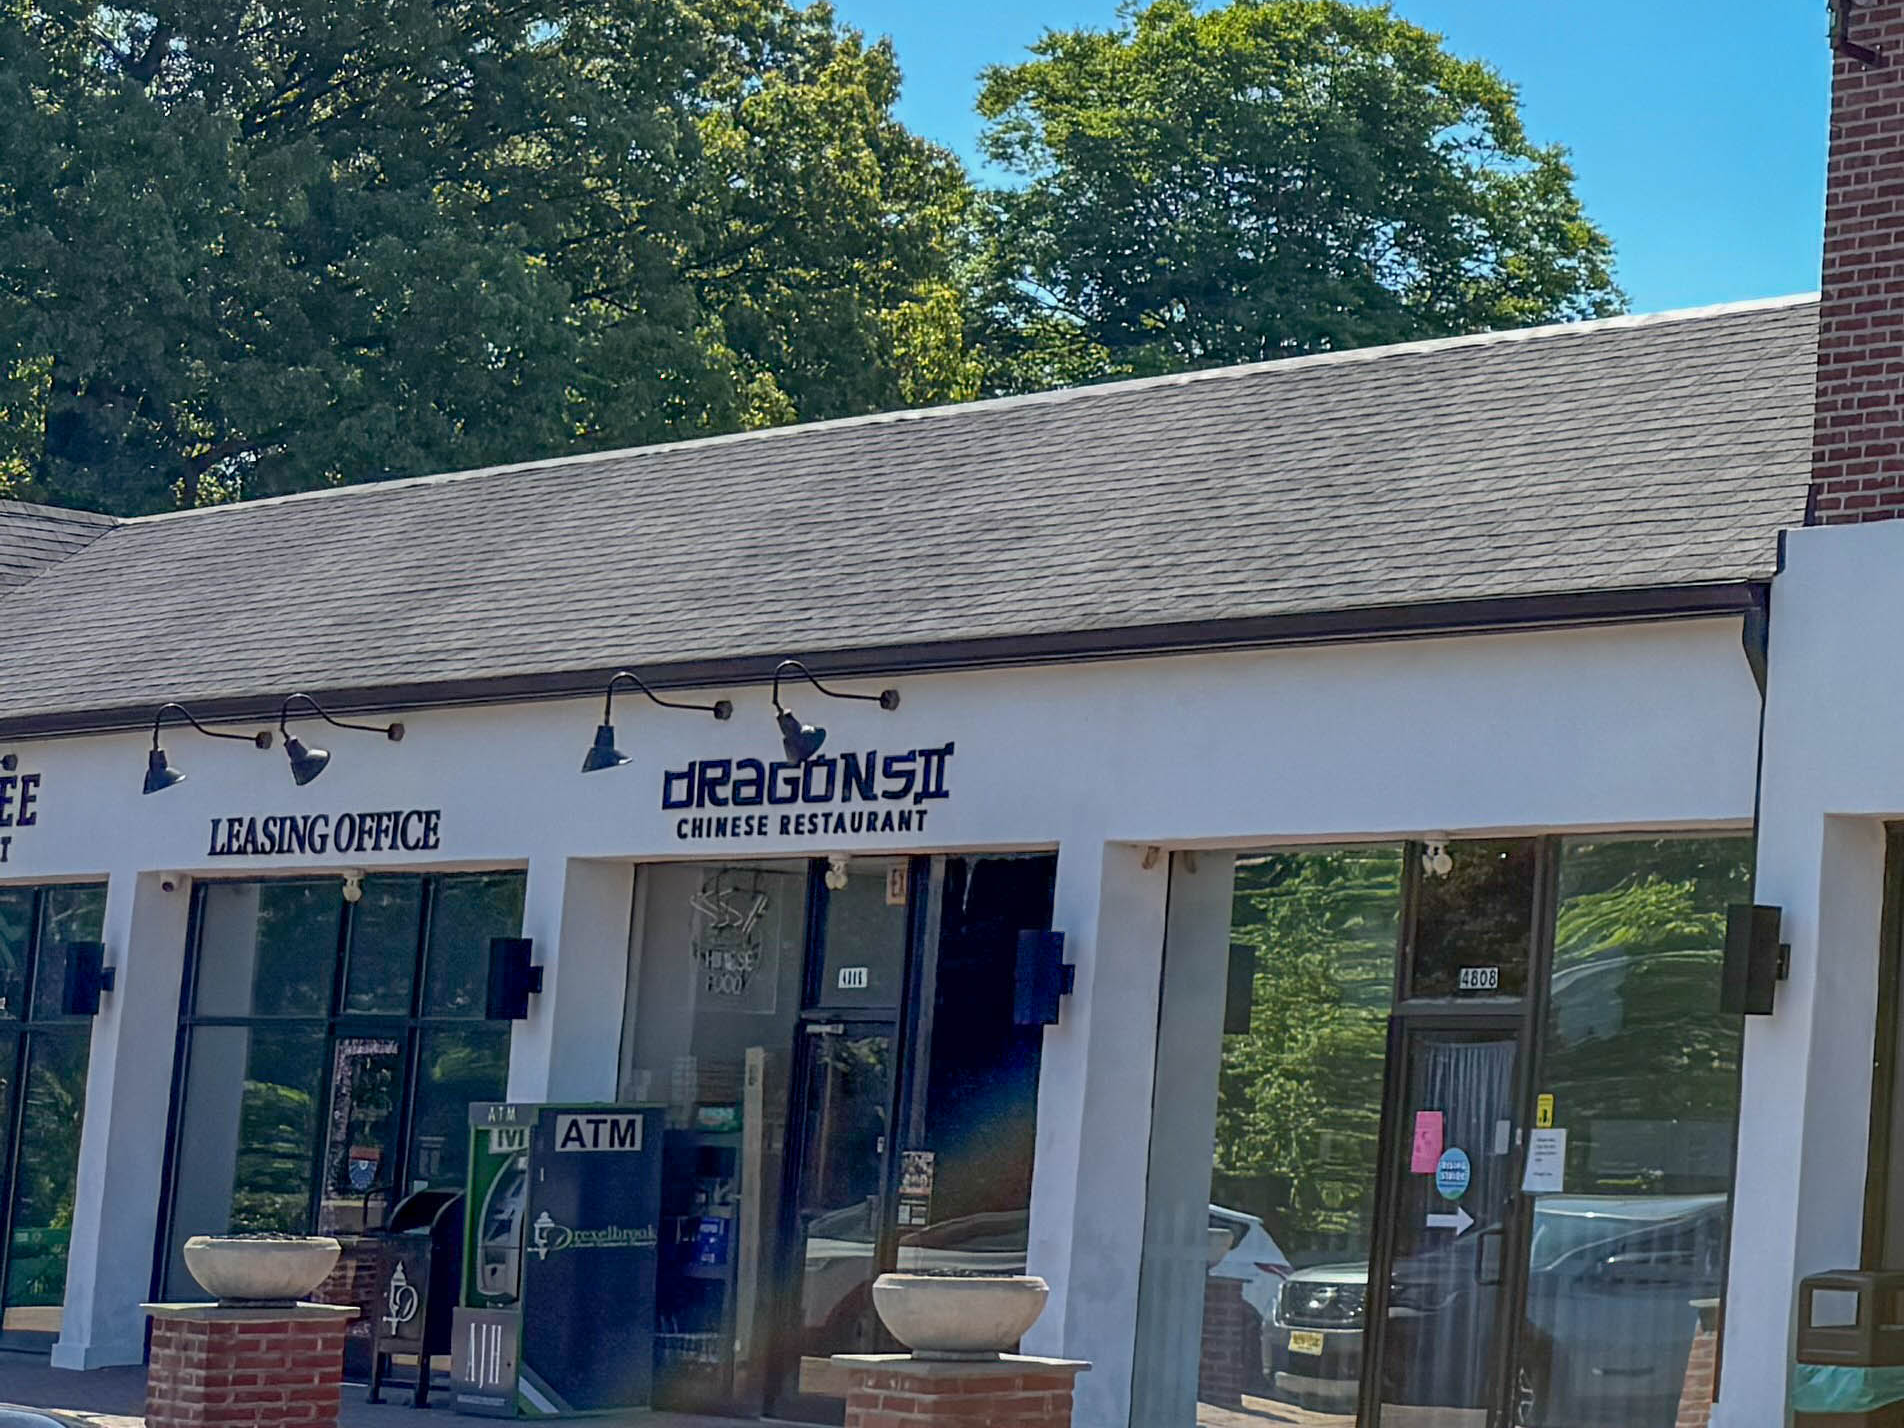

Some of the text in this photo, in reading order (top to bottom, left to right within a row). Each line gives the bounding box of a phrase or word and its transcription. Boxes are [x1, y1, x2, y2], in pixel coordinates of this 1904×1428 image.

[208, 810, 441, 856] LEASING OFFICE
[676, 810, 928, 839] CHINESE RESTAURANT
[1462, 969, 1496, 987] 4808
[488, 1106, 516, 1122] ATM
[561, 1119, 637, 1148] ATM
